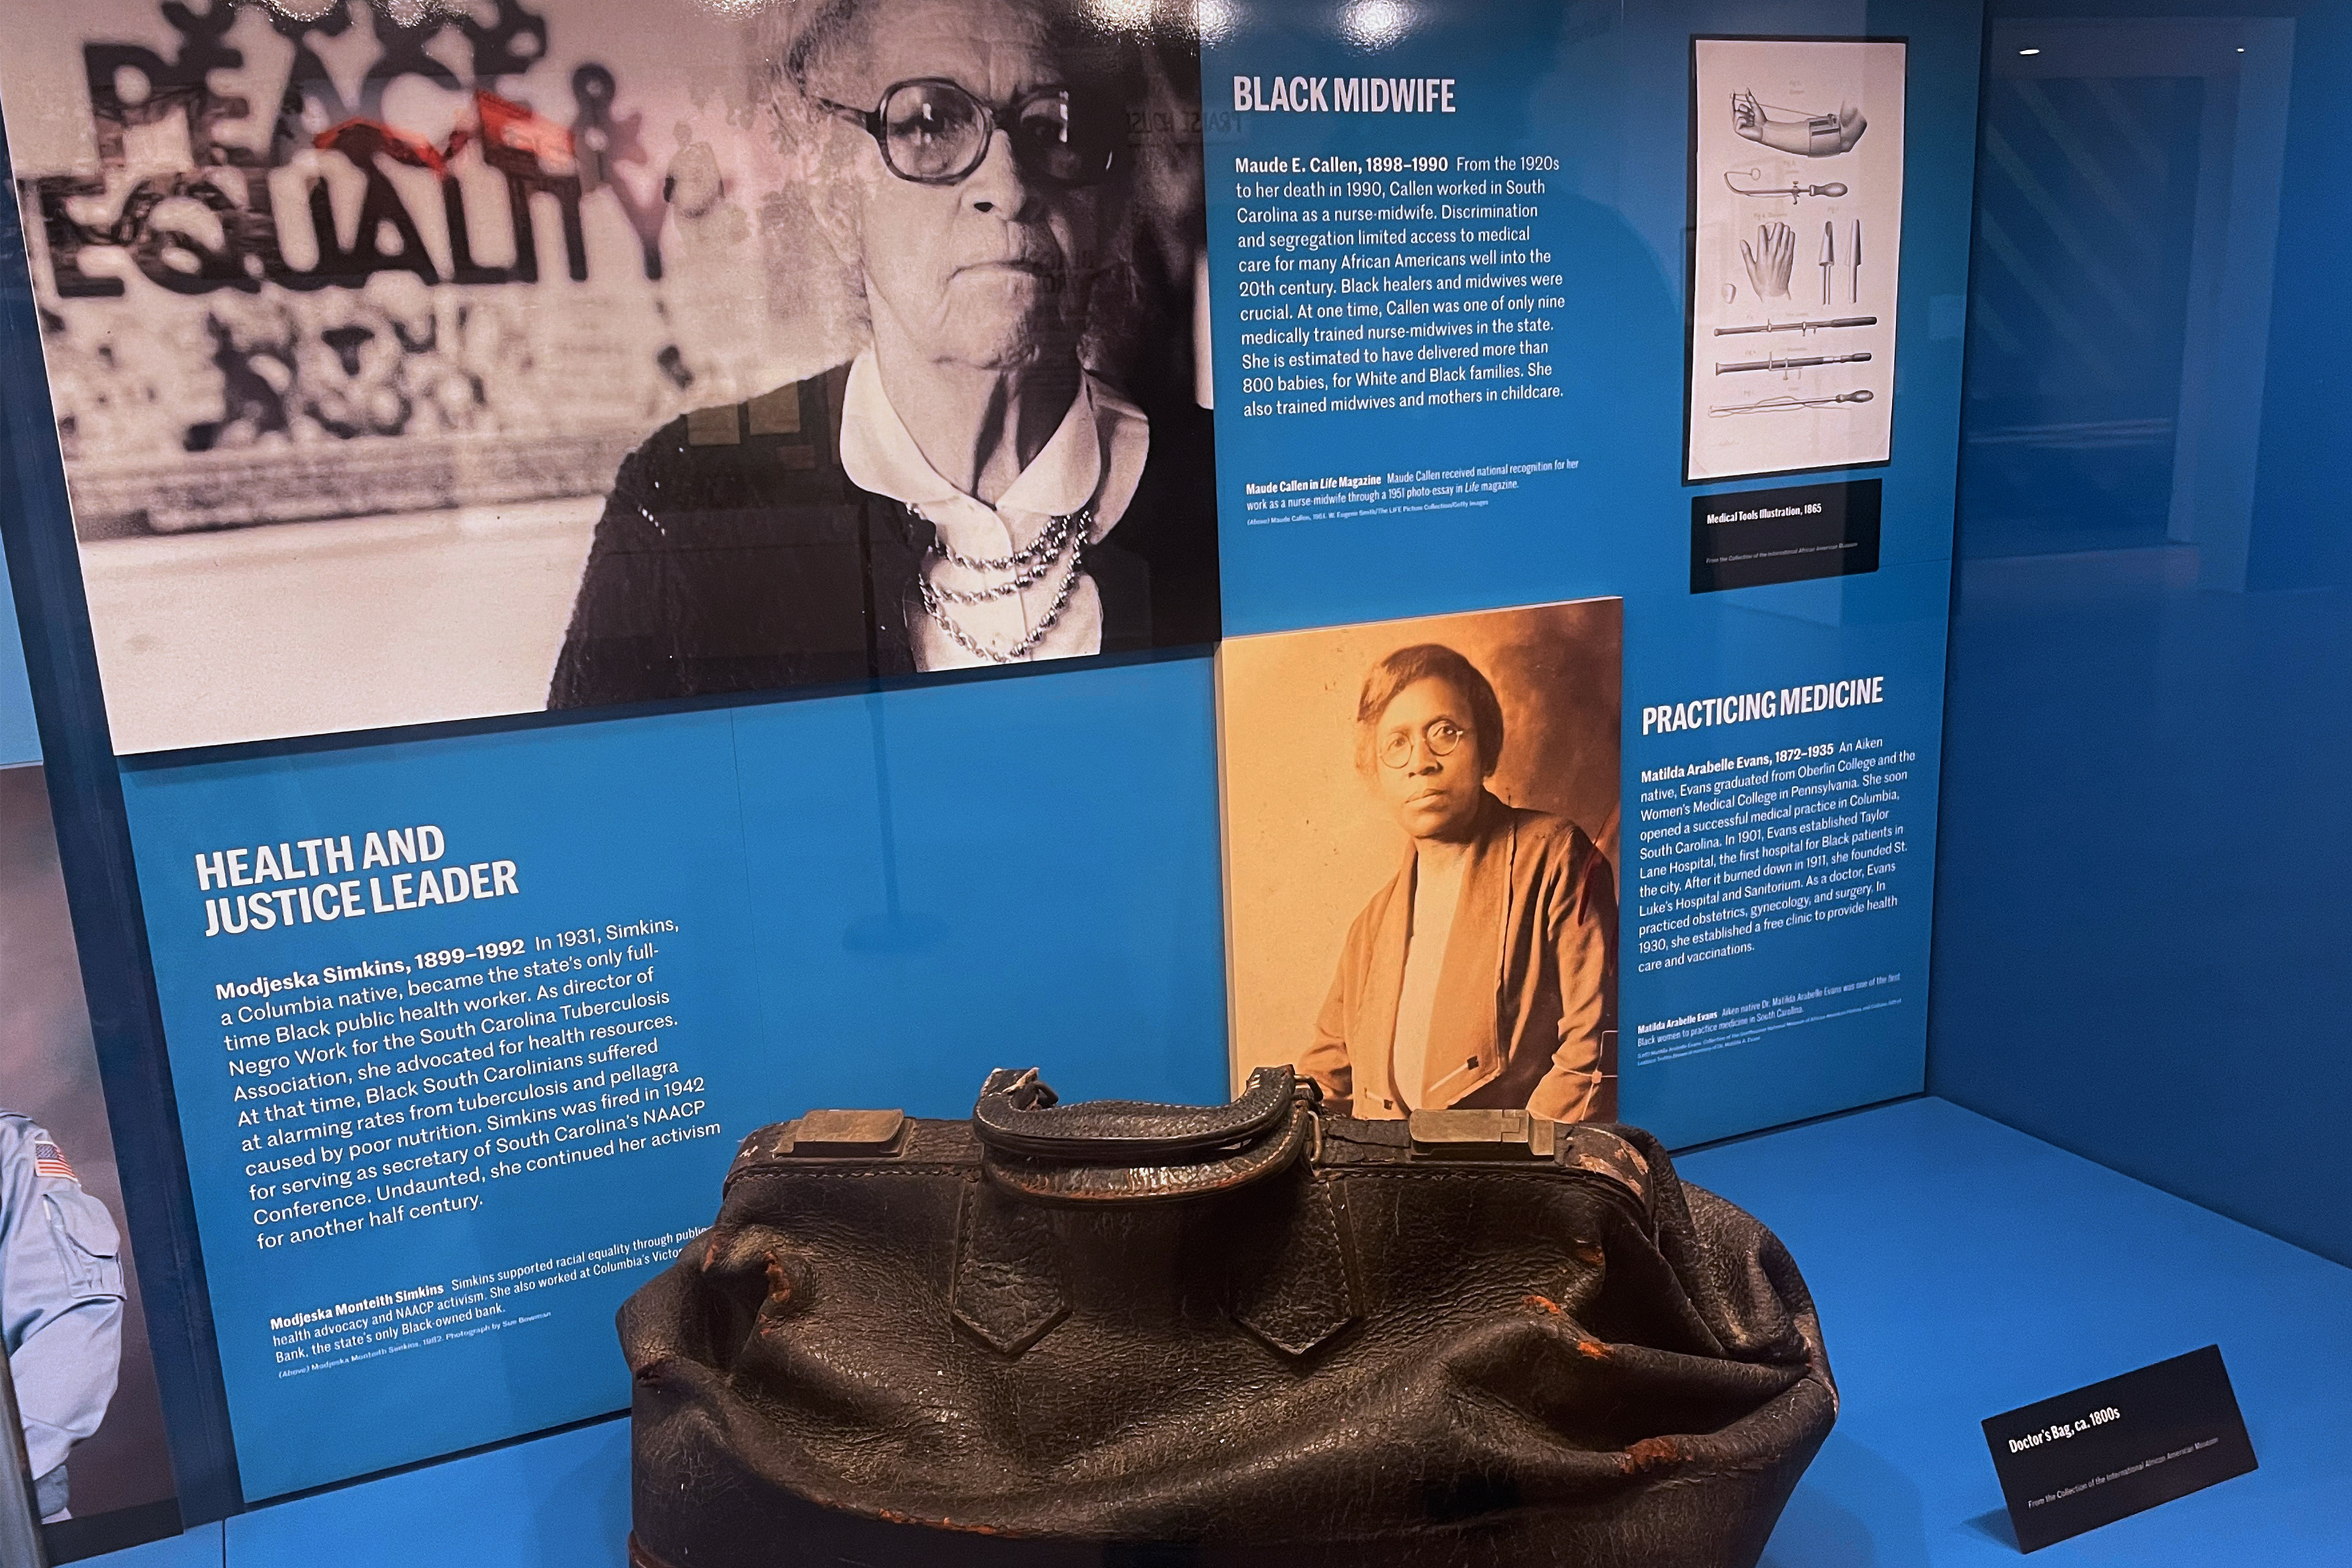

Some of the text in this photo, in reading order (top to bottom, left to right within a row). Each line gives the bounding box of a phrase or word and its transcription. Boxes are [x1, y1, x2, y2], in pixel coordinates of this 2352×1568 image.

[1234, 76, 1456, 113] BLACK MIDWIFE
[1235, 155, 1559, 175] Maude E. Callen, 1898–1990 From the 1920s
[1236, 178, 1545, 198] to her death in 1990, Callen worked in South
[29, 135, 666, 298] EQUALITY
[1237, 203, 1538, 223] Carolina as a nurse-midwife. Discrimination
[1246, 481, 1278, 495] Maude
[1279, 480, 1309, 492] Callen
[1309, 479, 1319, 490] in
[1320, 477, 1338, 489] Life
[1338, 475, 1382, 489] Magazine
[1387, 471, 1414, 484] Maude
[1415, 470, 1441, 481] Callen
[1442, 466, 1475, 479] received
[1477, 464, 1509, 476] national
[1509, 462, 1553, 475] recognition
[1246, 499, 1267, 511] work
[1269, 500, 1279, 510] as
[1280, 499, 1286, 508] a
[1348, 489, 1380, 503] through
[1381, 491, 1387, 500] a
[1389, 488, 1405, 499] 1951
[1455, 484, 1463, 493] in
[1464, 481, 1480, 493] Life
[1706, 503, 1822, 524] Medical Tools Illustration, 1865
[1643, 676, 1884, 736] PRACTICING MEDICINE
[1640, 750, 1915, 802] native, Evans graduated from Oberlin College and the
[1641, 737, 1883, 783] Matilda Arabelle Evans, 1872–1935 An Aiken
[1640, 771, 1907, 822] Women's Medical College in Pennsylvania. She soon
[195, 825, 445, 891] HEALTH AND
[205, 860, 519, 937] JUSTICE LEADER
[216, 919, 679, 1000] Modjeska Simkins, 1899–1992 In 1931, Simkins,
[221, 942, 659, 1026] a Columbia native, became the state's only full-
[223, 966, 654, 1051] time Black public health worker. As director of
[1637, 1035, 1656, 1047] Black
[1656, 1031, 1681, 1043] women
[1682, 1029, 1690, 1038] to
[1691, 1024, 1717, 1037] practice
[1756, 1010, 1776, 1022] South
[270, 1308, 333, 1330] Modjeska
[334, 1294, 393, 1316] Monteith
[394, 1284, 444, 1303] Simkins
[451, 1274, 495, 1291] Simkins
[497, 1258, 553, 1281] supported
[556, 1251, 585, 1268] racial
[587, 1243, 630, 1261] equality
[633, 1232, 673, 1251] through
[311, 1342, 331, 1355] the
[334, 1332, 372, 1350] state's
[375, 1327, 398, 1341] only
[402, 1311, 473, 1335] Black-owned
[475, 1305, 506, 1319] bank.
[2009, 1408, 2120, 1453] Doctor's Bag, ca. 1800s
